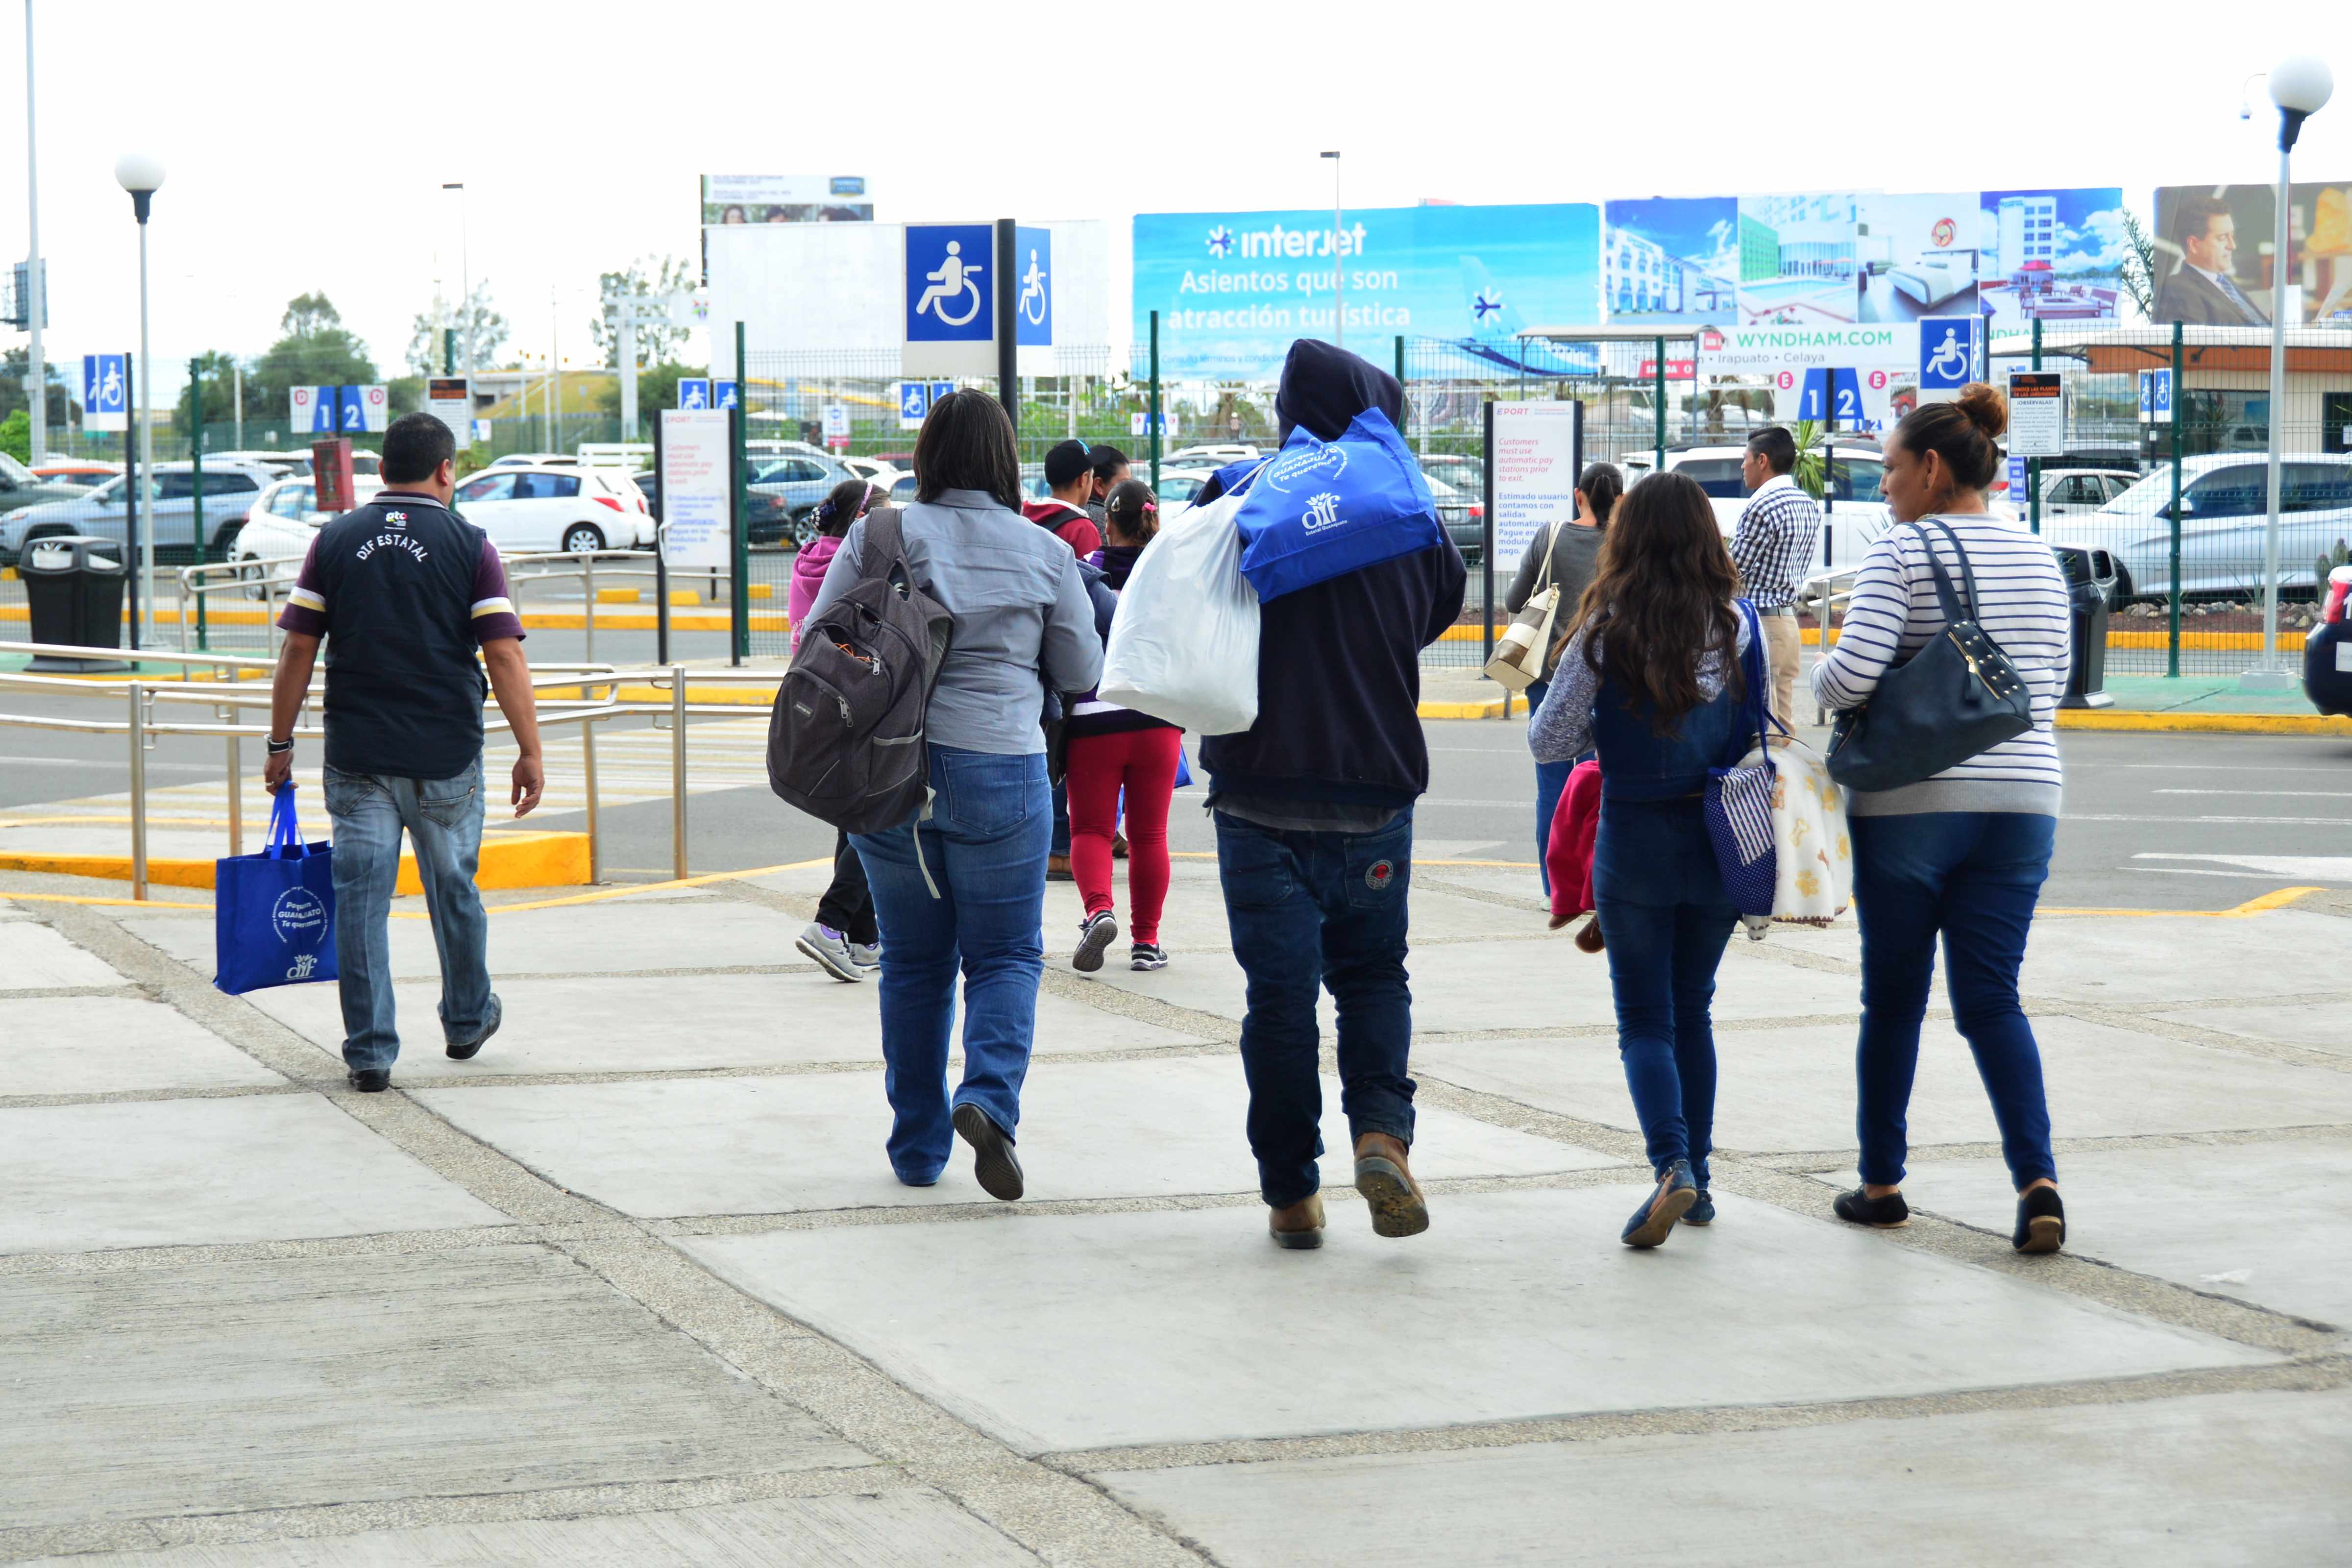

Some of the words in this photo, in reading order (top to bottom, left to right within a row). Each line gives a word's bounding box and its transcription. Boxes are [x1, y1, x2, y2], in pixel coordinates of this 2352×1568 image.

[1180, 269, 1289, 294] Asientos
[1352, 270, 1397, 291] son
[1168, 303, 1290, 330] atracción
[1299, 301, 1410, 328] turística
[1737, 332, 1891, 347] WYNDHAM.COM
[1718, 353, 1769, 364] Irapuato
[1784, 352, 1825, 363] Celaya
[1809, 390, 1817, 416] 1
[1838, 389, 1854, 416] 2
[320, 404, 330, 428] 1
[344, 404, 360, 428] 2
[1498, 529, 1523, 538] Pague
[356, 540, 375, 560] DIF
[376, 534, 428, 562] ESTATAL
